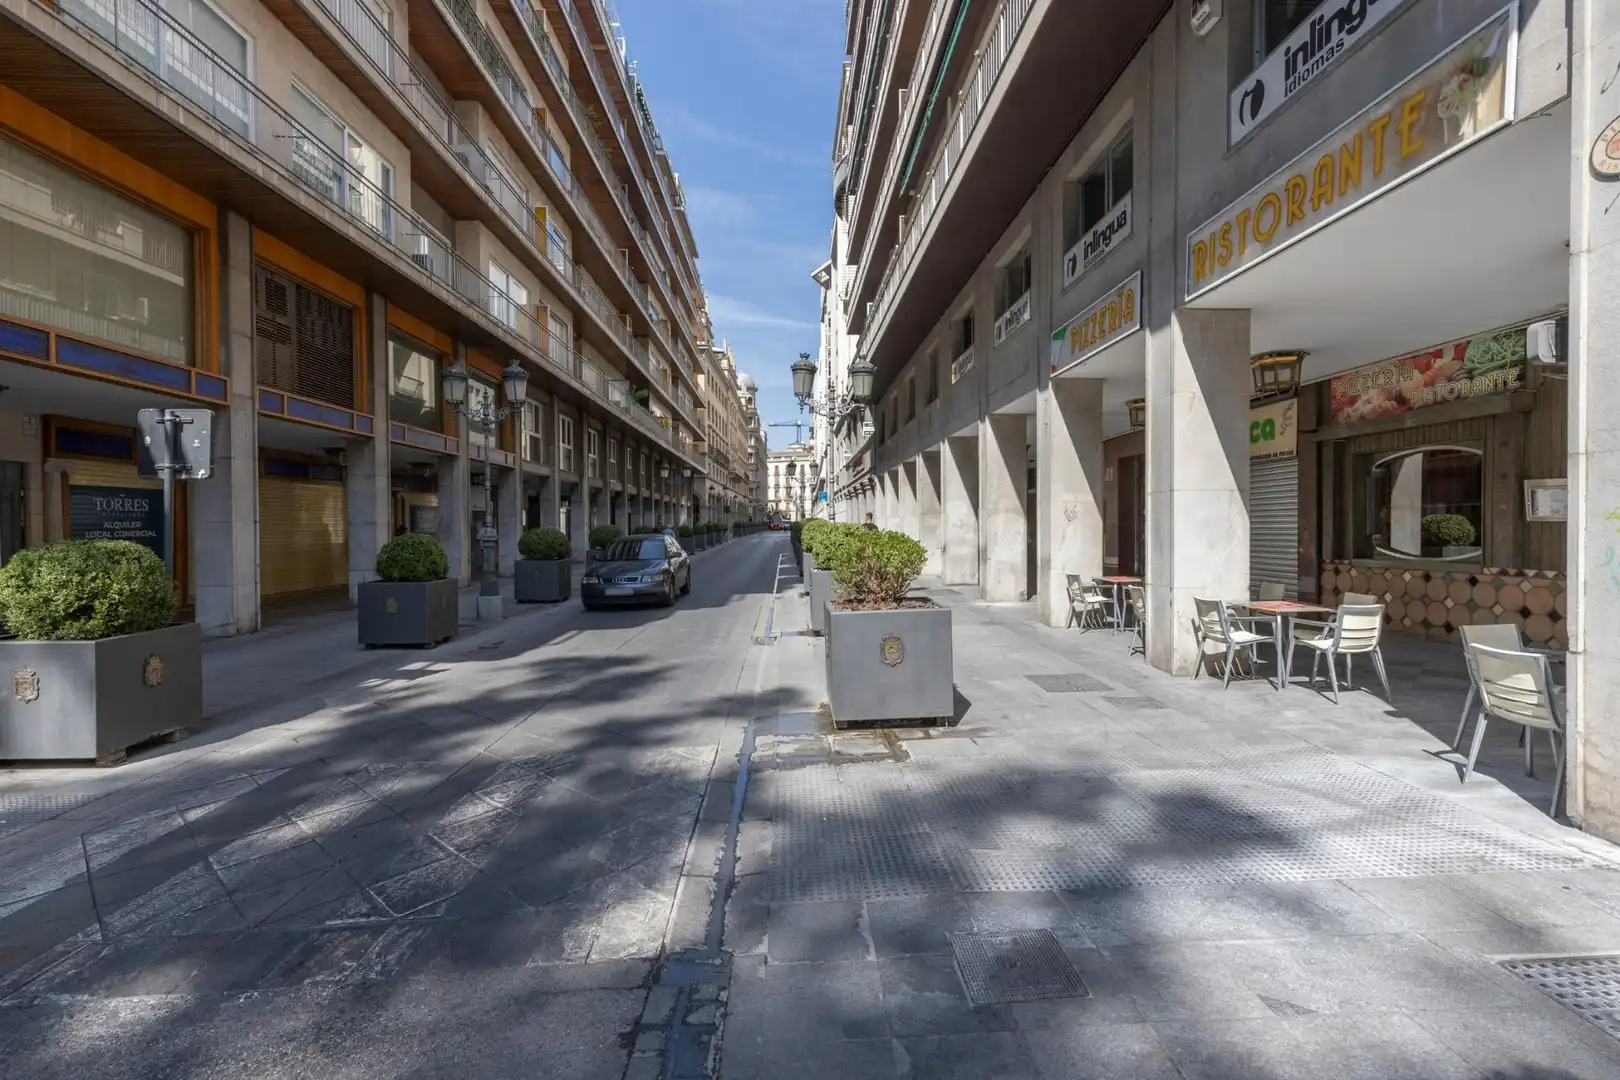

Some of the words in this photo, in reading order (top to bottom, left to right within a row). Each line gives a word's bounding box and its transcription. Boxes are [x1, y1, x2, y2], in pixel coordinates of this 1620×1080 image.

[1284, 0, 1379, 82] inling
[1284, 38, 1345, 98] idiomas
[1191, 87, 1428, 283] RISTORANTE
[1083, 209, 1127, 261] inlingua
[1410, 367, 1520, 405] RISTORANTE
[92, 497, 149, 512] TORRES
[102, 521, 142, 529] ALQUILER
[84, 531, 113, 539] LOCAL
[113, 530, 157, 538] COMERCIAL
